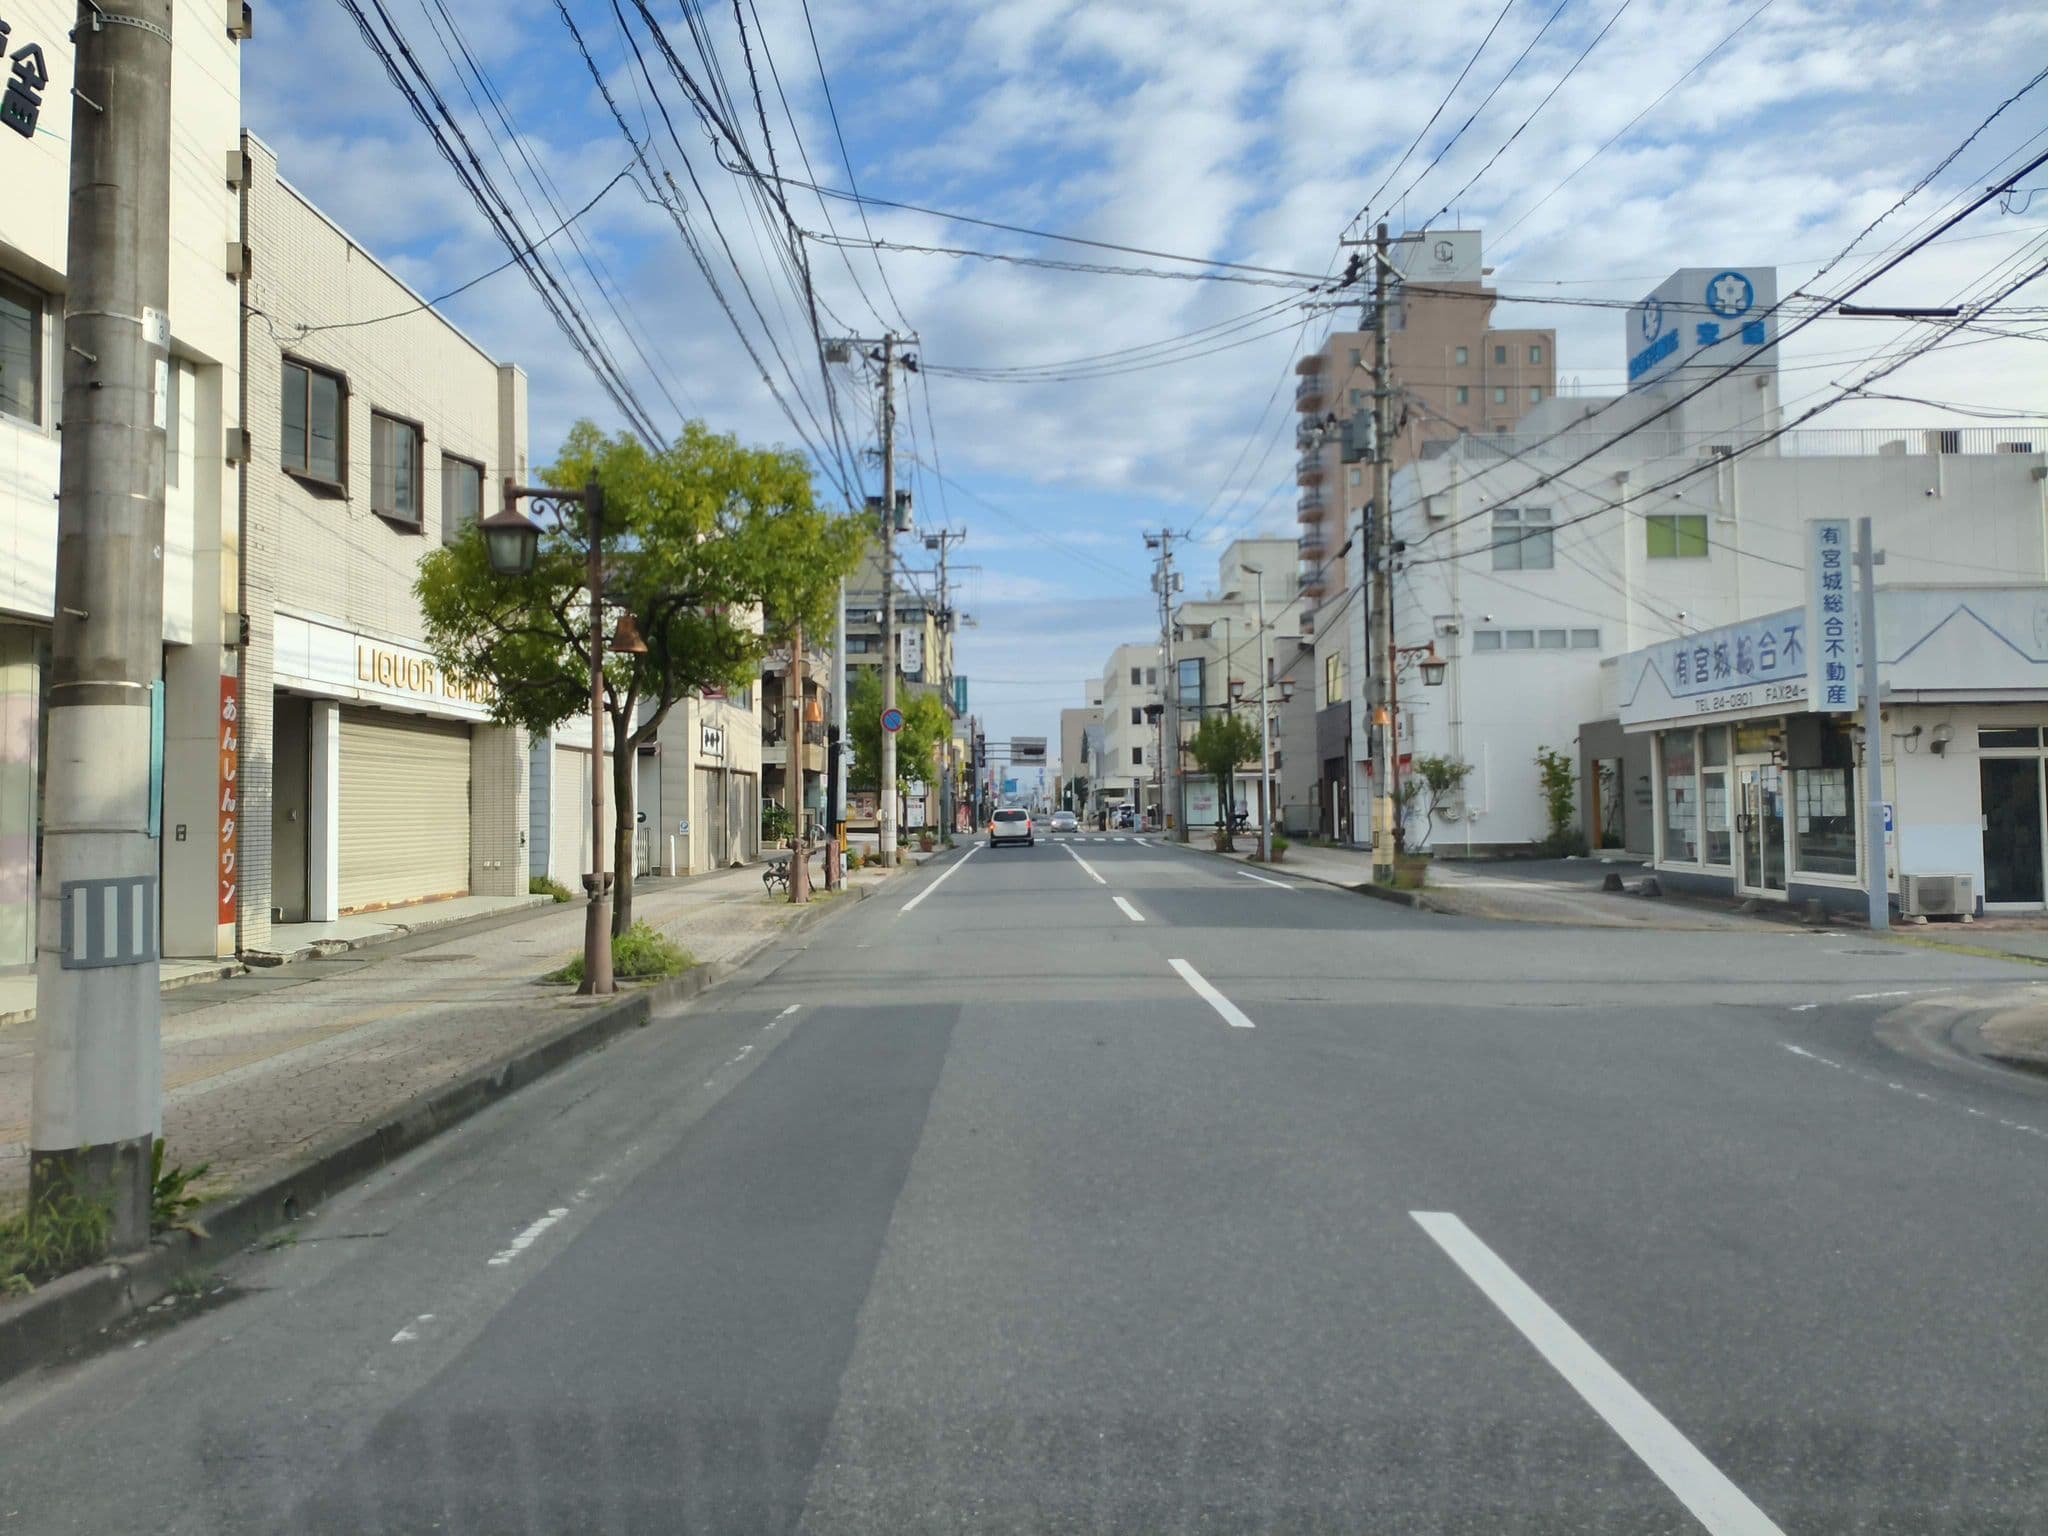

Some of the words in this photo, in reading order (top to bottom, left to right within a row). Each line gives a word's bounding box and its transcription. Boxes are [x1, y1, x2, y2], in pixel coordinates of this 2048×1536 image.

[358, 645, 436, 694] LIQUOR
[1695, 699, 1710, 712] TEL
[221, 695, 238, 905] あんしんタウン
